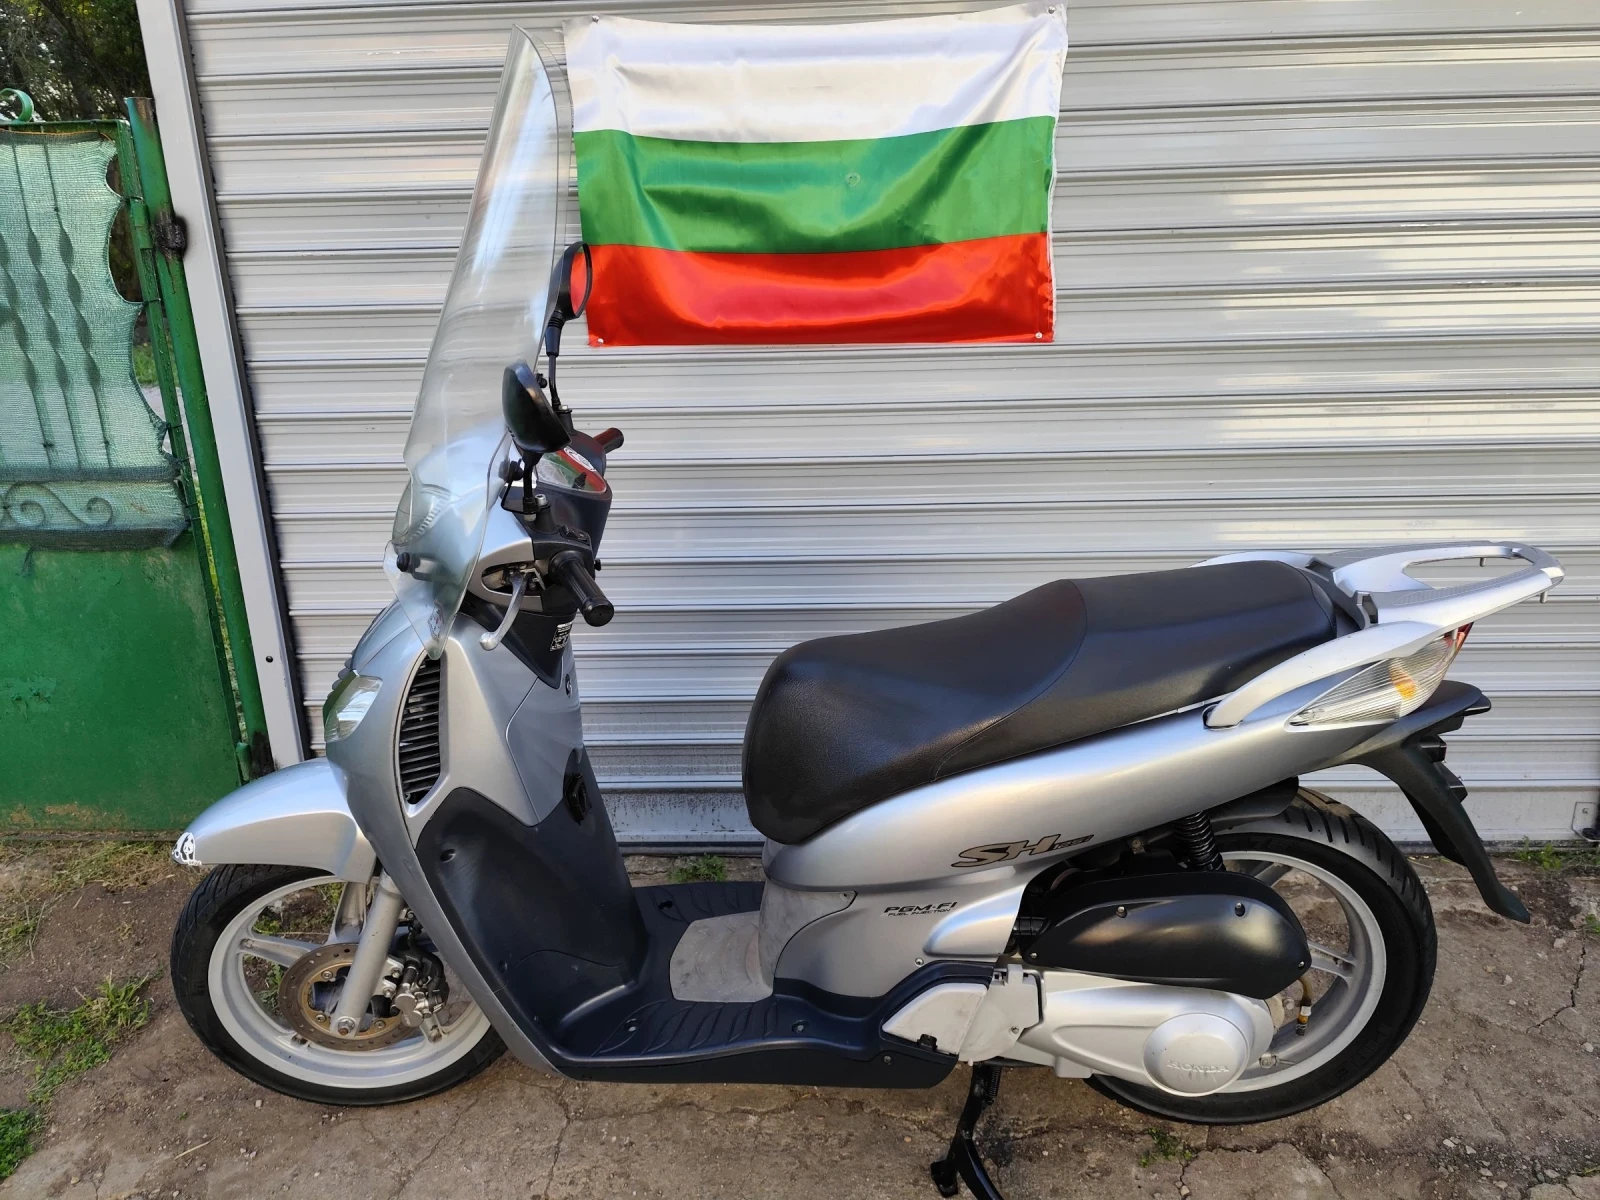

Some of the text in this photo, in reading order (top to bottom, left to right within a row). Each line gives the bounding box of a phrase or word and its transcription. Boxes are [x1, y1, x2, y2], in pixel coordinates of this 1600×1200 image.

[951, 833, 1061, 868] SH
[911, 908, 951, 916] INJECTION
[1166, 1060, 1230, 1073] HONDA
